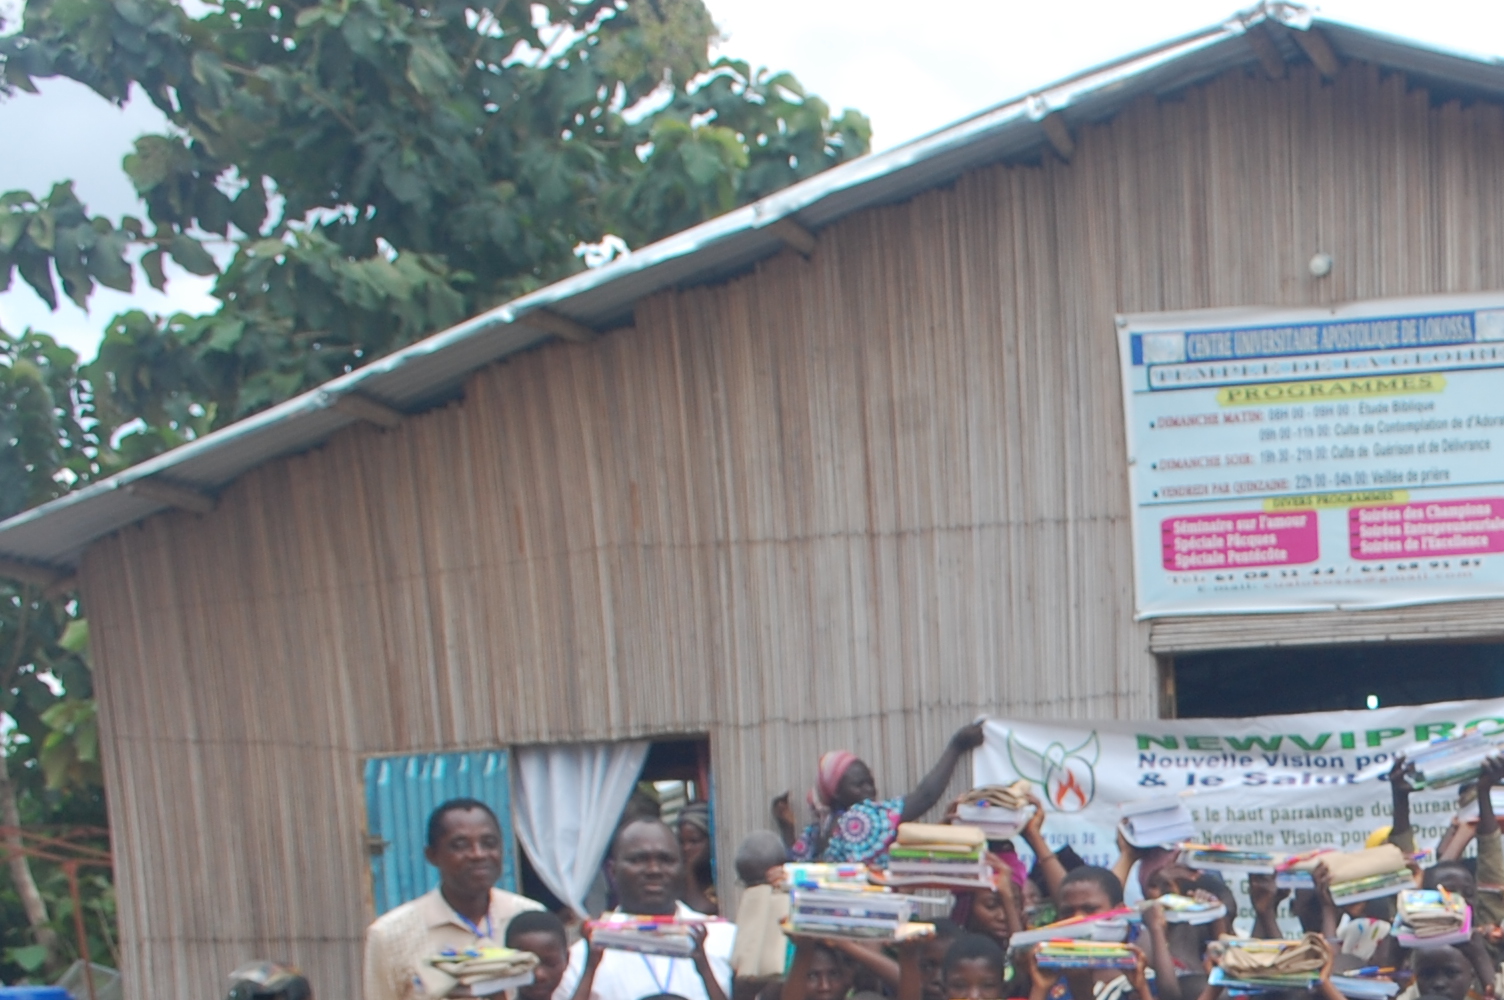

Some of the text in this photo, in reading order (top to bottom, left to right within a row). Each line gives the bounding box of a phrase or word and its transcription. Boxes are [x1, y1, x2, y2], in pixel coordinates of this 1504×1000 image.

[1188, 315, 1474, 360] CENTRE UNIVERSITAIRE APOSTOLIQUE DE LOKOSSA
[1227, 376, 1434, 401] PROGRAMMES
[1157, 412, 1219, 428] DIMANCHE
[1224, 410, 1263, 425] MATIN:
[1358, 400, 1389, 415] Étude
[1392, 399, 1435, 415] Biblique
[1334, 421, 1359, 436] Culte
[1363, 421, 1374, 434] de
[1377, 418, 1448, 435] Contemplation
[1451, 416, 1463, 430] de
[1158, 455, 1220, 471] DIMANCHE
[1331, 443, 1355, 459] Culte
[1357, 443, 1369, 457] de
[1373, 440, 1414, 456] Guérison
[1417, 440, 1427, 454] et
[1428, 439, 1439, 454] de
[1441, 437, 1490, 453] Délivrance
[1161, 483, 1209, 497] VENDREDI
[1212, 481, 1230, 494] PAR
[1372, 468, 1403, 485] Veillée
[1406, 468, 1418, 482] de
[1421, 467, 1451, 485] prière
[1272, 492, 1394, 508] DIVERS PROGRAMMES
[1358, 503, 1492, 523] Soirées des Champions
[1173, 518, 1234, 535] Séminaire
[1236, 518, 1256, 532] sur
[1359, 522, 1401, 538] Soirées
[1174, 535, 1225, 553] Spéciale
[1360, 538, 1402, 554] Soirées
[1404, 537, 1419, 551] de
[1174, 550, 1226, 570] Spéciale
[1138, 752, 1253, 769] Nouvelle
[1263, 752, 1345, 769] Vision
[1138, 771, 1356, 787] & le Salut
[1206, 806, 1220, 822] le
[1226, 805, 1264, 822] haut
[1271, 802, 1364, 824] parrainage
[1371, 802, 1393, 818] du
[1280, 830, 1334, 846] Vision
[1341, 830, 1370, 846] pou
